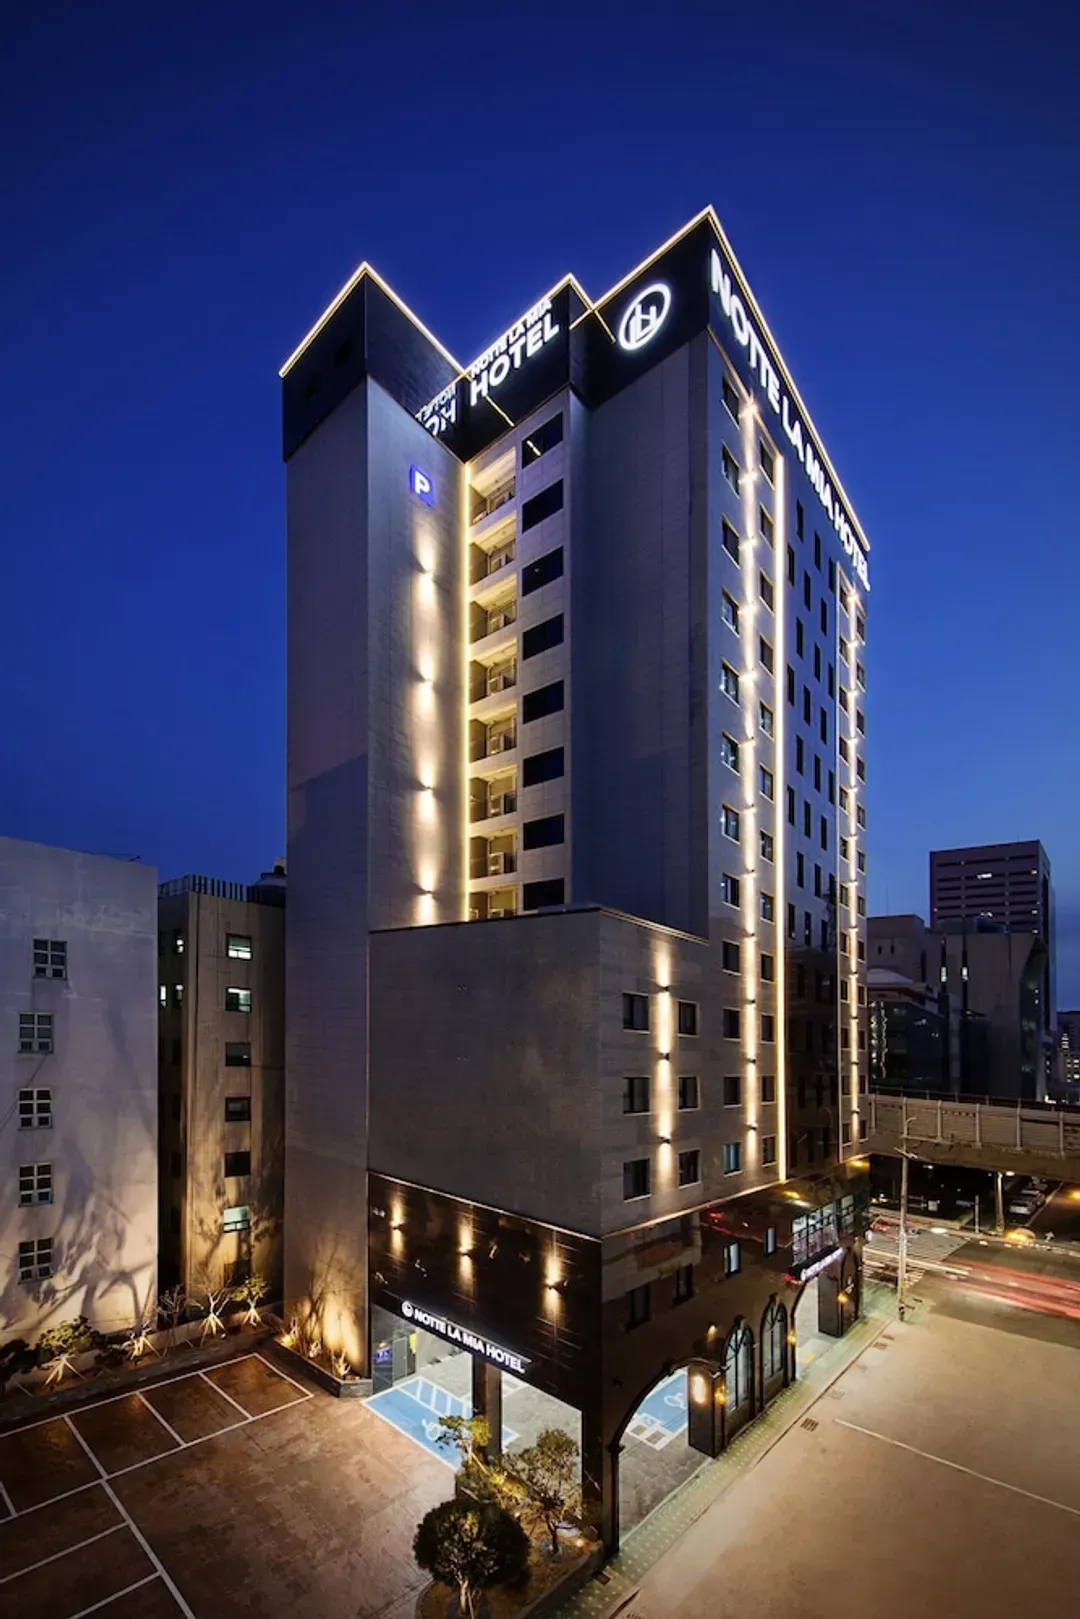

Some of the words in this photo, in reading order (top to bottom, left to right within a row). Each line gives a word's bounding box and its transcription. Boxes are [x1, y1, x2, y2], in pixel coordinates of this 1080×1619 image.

[471, 313, 560, 406] HOTEL
[711, 248, 780, 414] NOTTE
[782, 395, 804, 462] LA
[806, 443, 834, 520] MIA
[834, 502, 870, 591] HOTEL
[414, 1308, 446, 1334] NOTTE
[447, 1324, 461, 1342] LA
[462, 1332, 485, 1354] MIA
[486, 1343, 525, 1374] HOTEL
